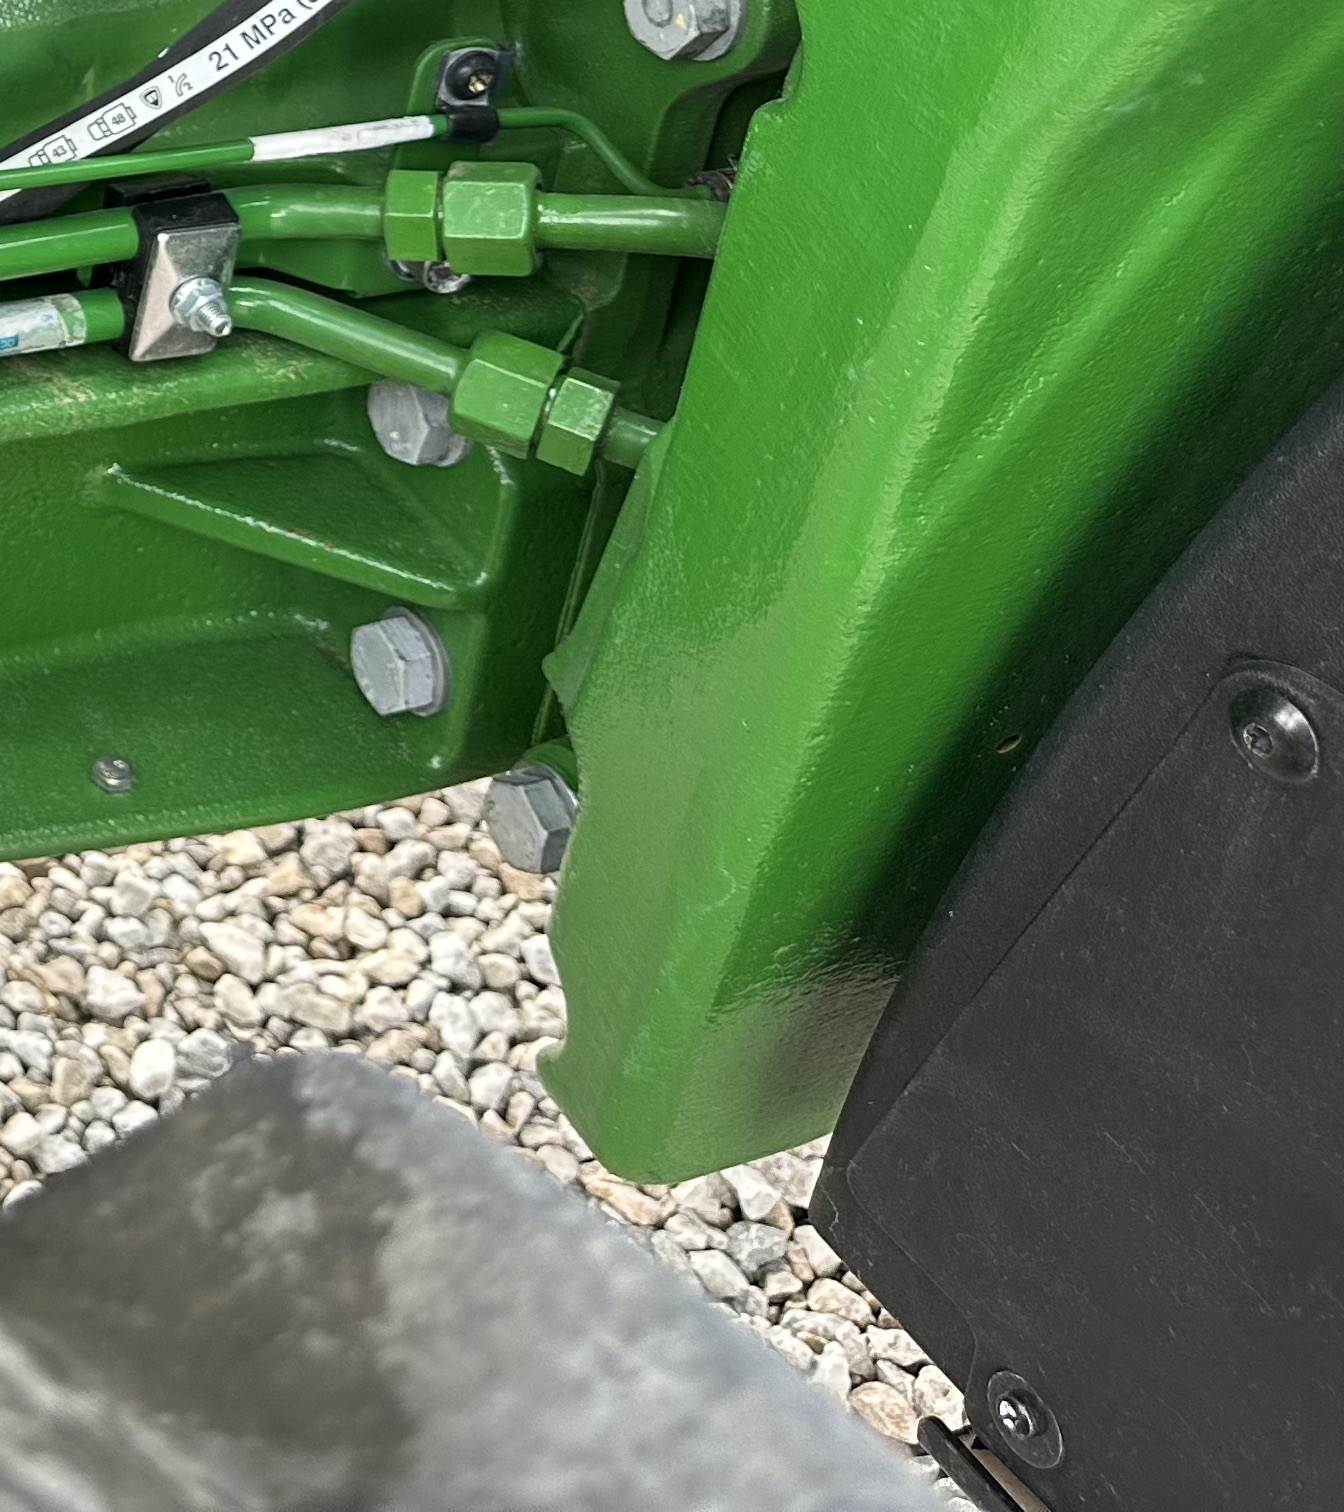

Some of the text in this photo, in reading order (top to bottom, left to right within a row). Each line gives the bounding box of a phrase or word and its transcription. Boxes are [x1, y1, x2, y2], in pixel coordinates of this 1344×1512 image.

[207, 42, 240, 73] 21
[239, 7, 297, 50] MPa
[51, 144, 68, 158] 43
